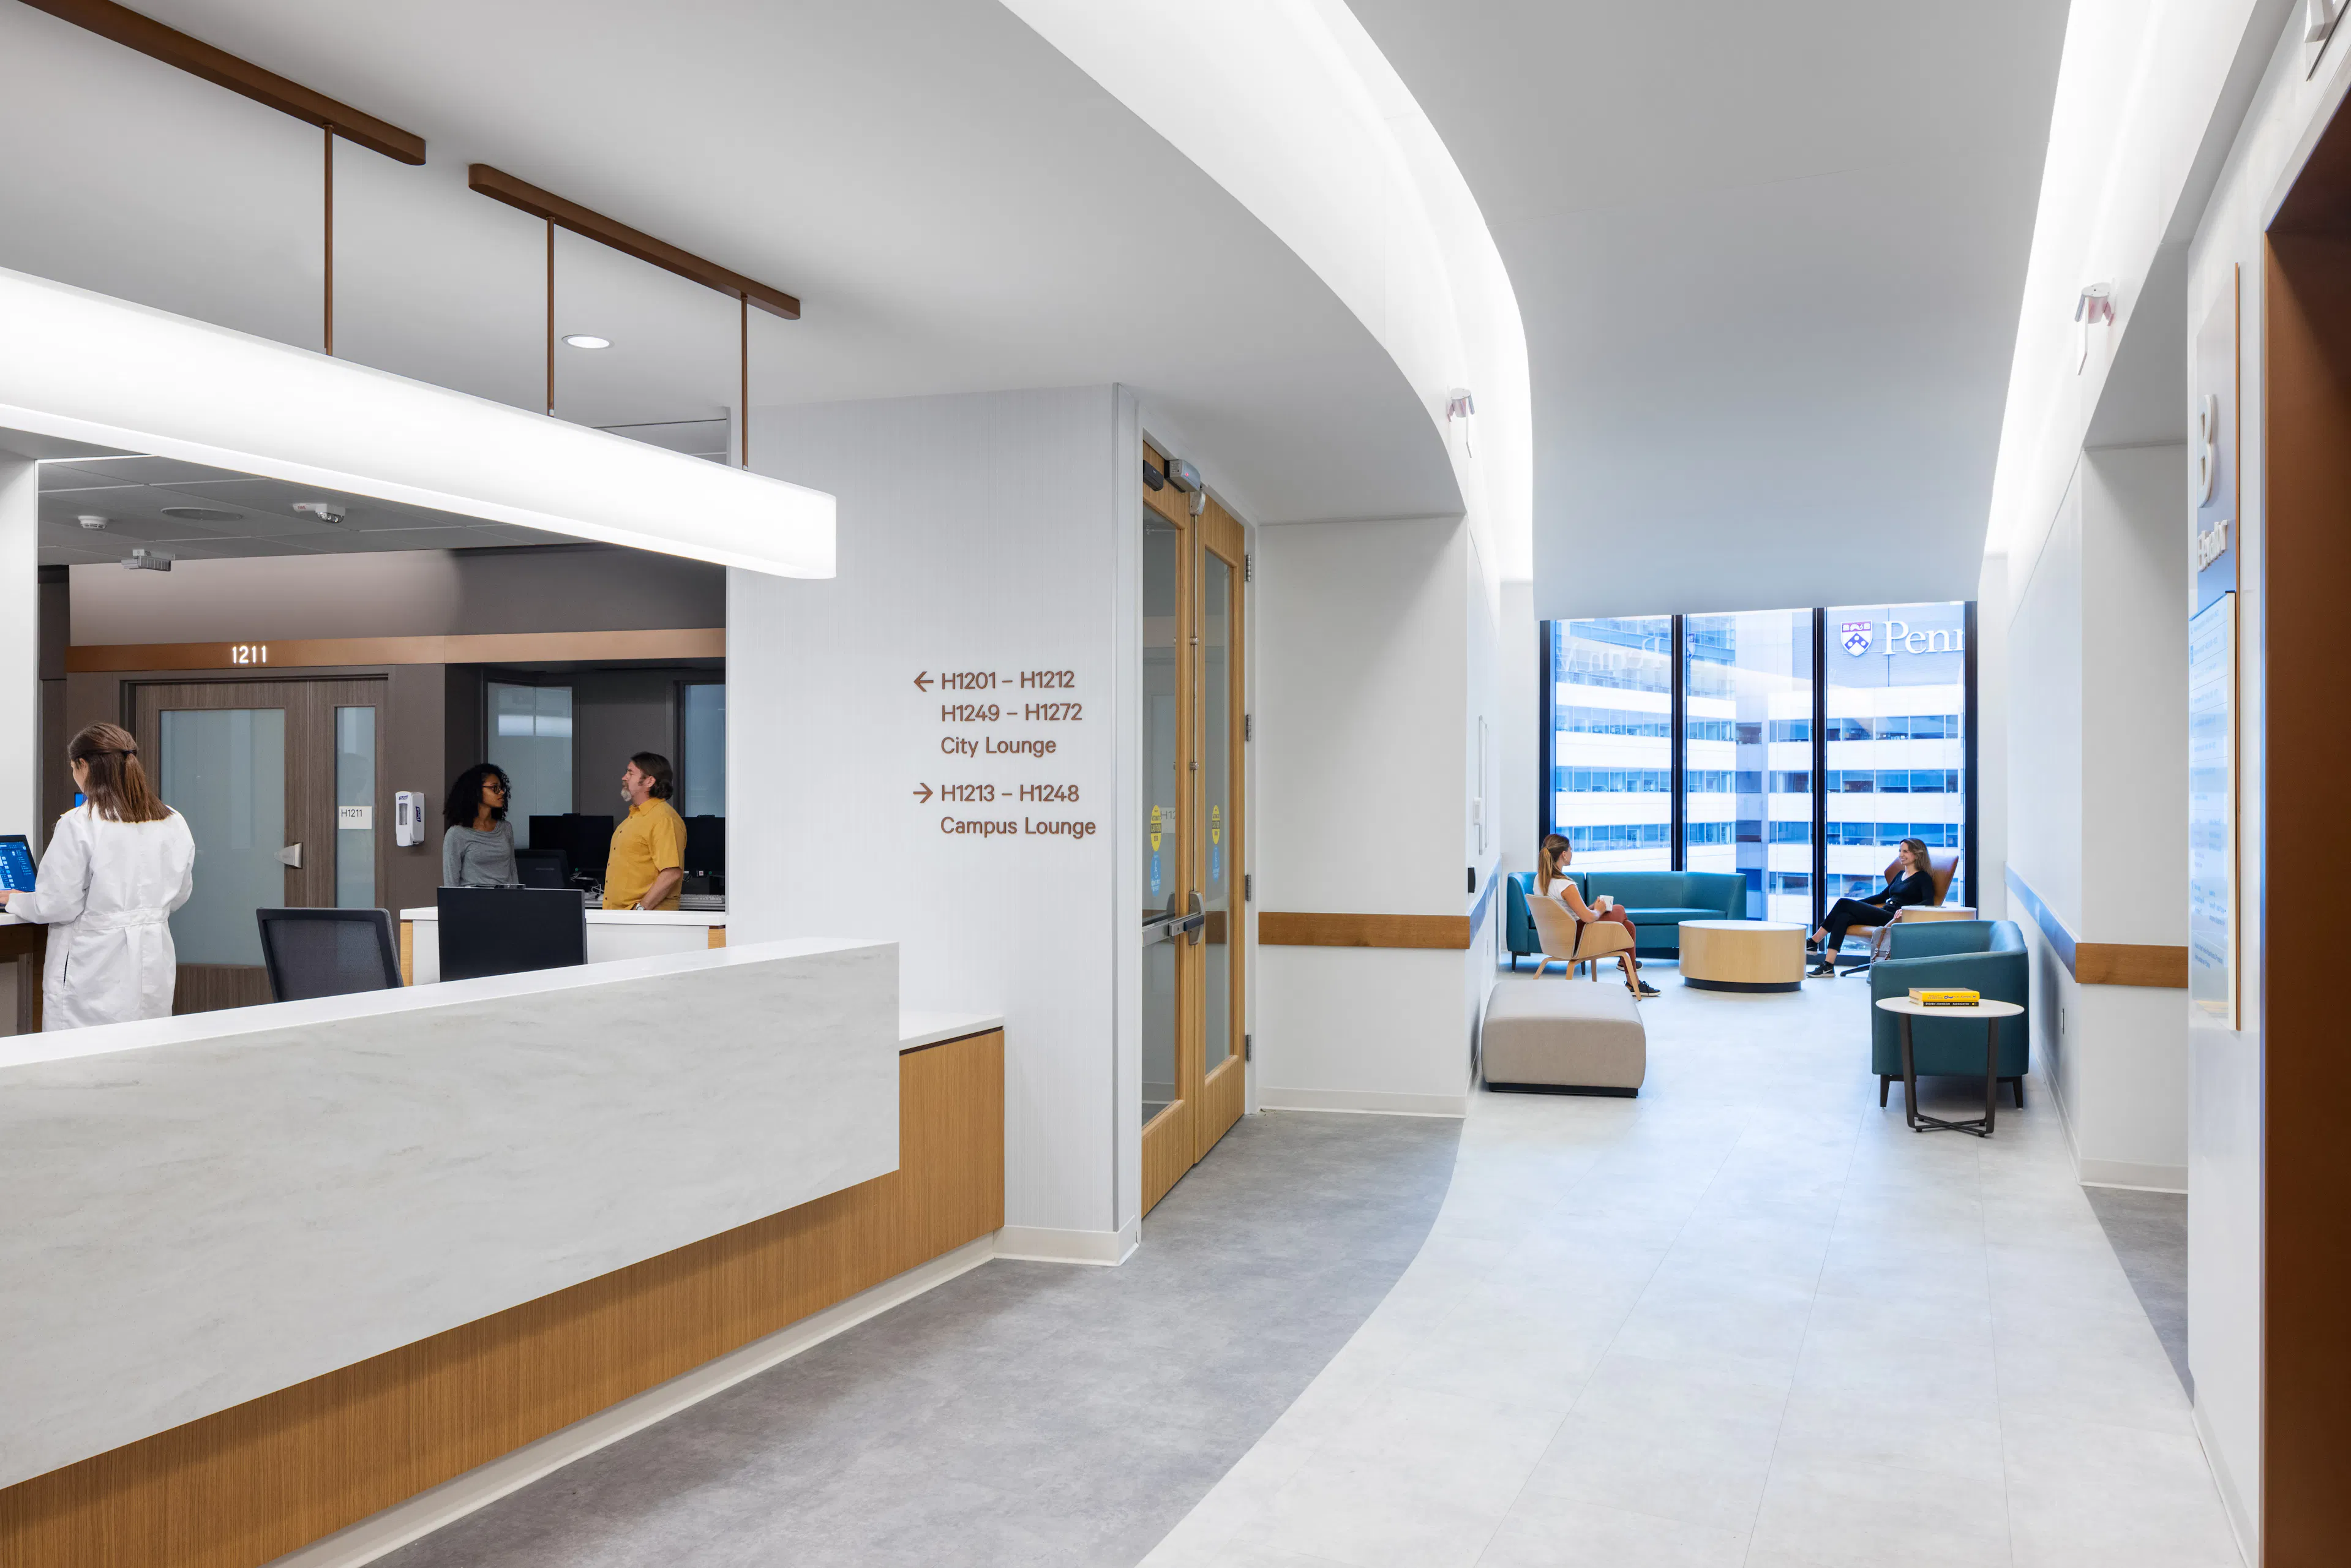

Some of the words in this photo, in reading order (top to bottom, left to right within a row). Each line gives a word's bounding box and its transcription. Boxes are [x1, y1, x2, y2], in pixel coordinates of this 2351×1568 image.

[232, 645, 266, 663] 1211
[942, 672, 996, 690] H1201
[1021, 671, 1074, 689] H1212
[942, 705, 999, 722] H1249
[1026, 703, 1082, 720] H1272
[942, 738, 978, 758] City
[986, 737, 1056, 758] Lounge
[942, 785, 994, 802] H1213
[1020, 785, 1079, 802] H1248
[341, 809, 362, 817] H1211
[941, 817, 1017, 838] Campus
[1026, 818, 1095, 839] Lounge
